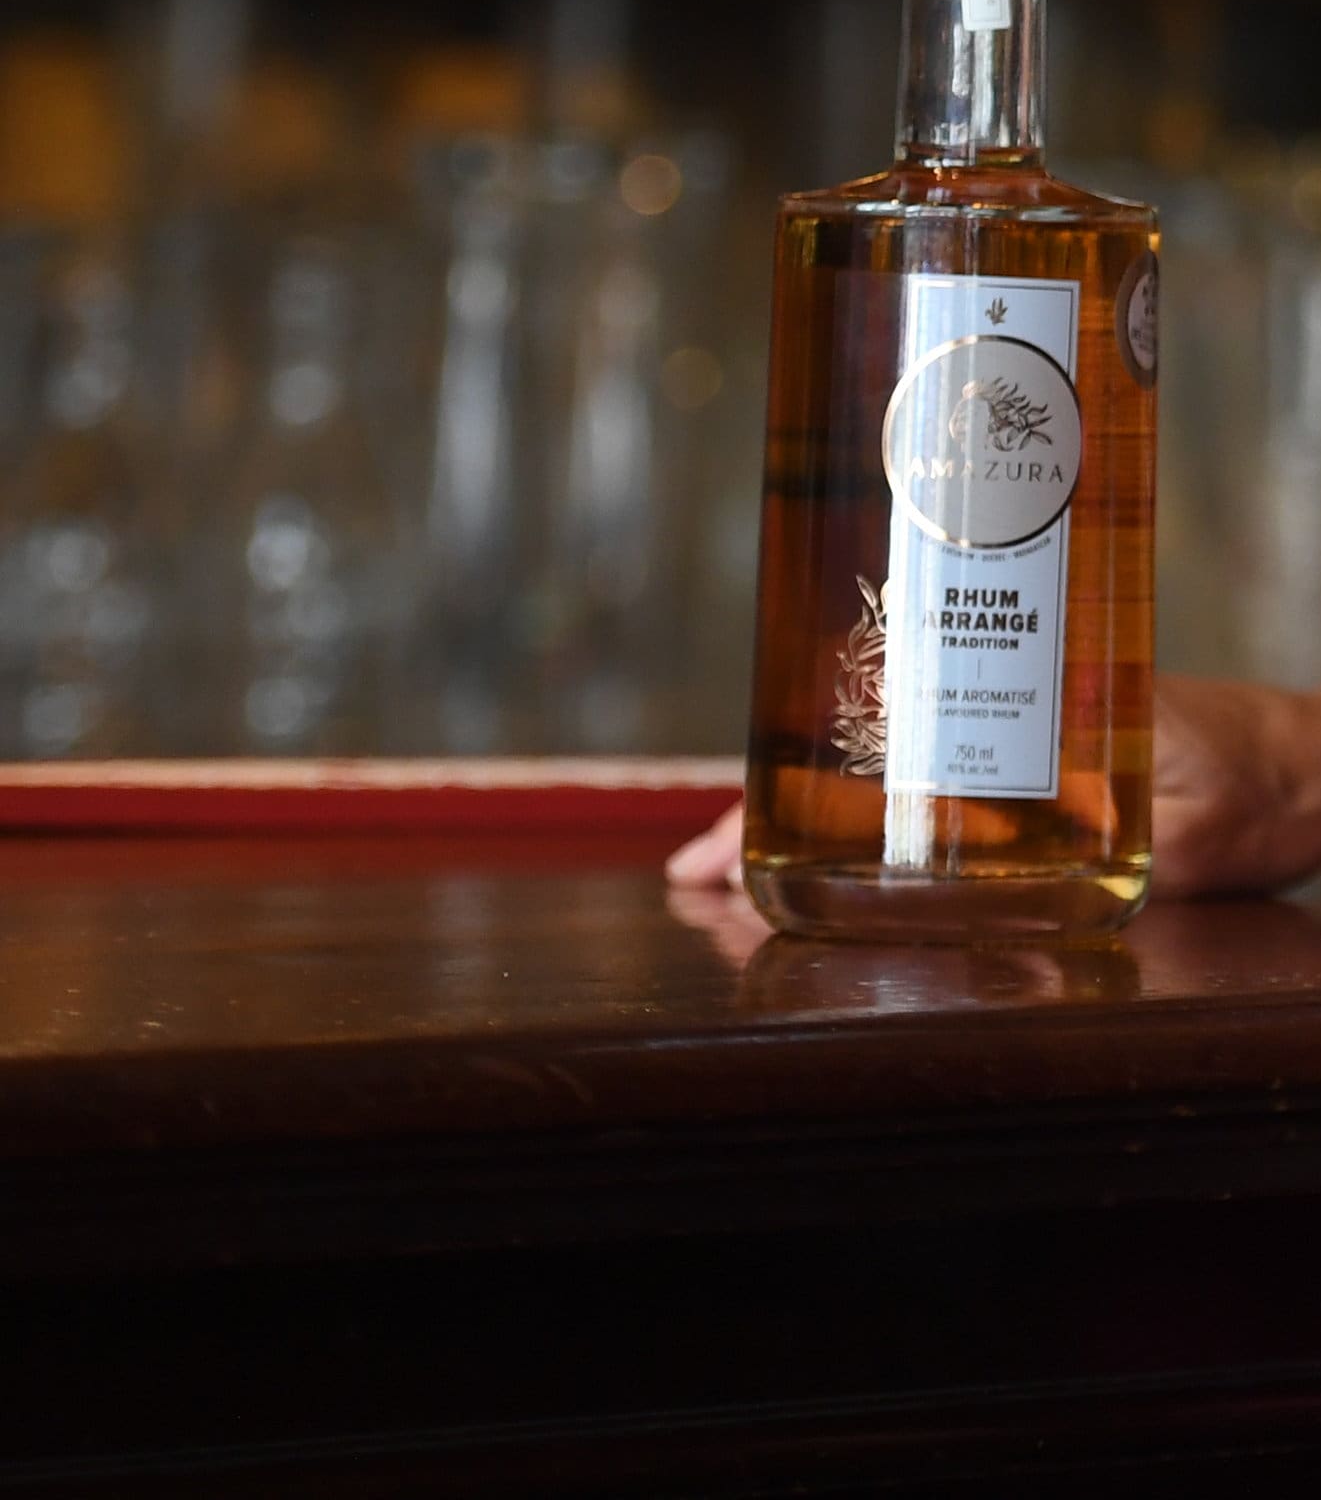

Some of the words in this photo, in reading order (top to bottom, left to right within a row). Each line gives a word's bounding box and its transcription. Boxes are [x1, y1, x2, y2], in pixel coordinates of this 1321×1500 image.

[909, 457, 1063, 483] AMAZURA
[944, 588, 1019, 609] RHUM
[923, 608, 1039, 633] ARRANGÉ
[941, 636, 1019, 650] TRADITION
[961, 688, 1037, 706] AROMATISÉ
[932, 708, 989, 719] LAVOURED
[955, 745, 975, 761] 750
[979, 746, 994, 761] ml
